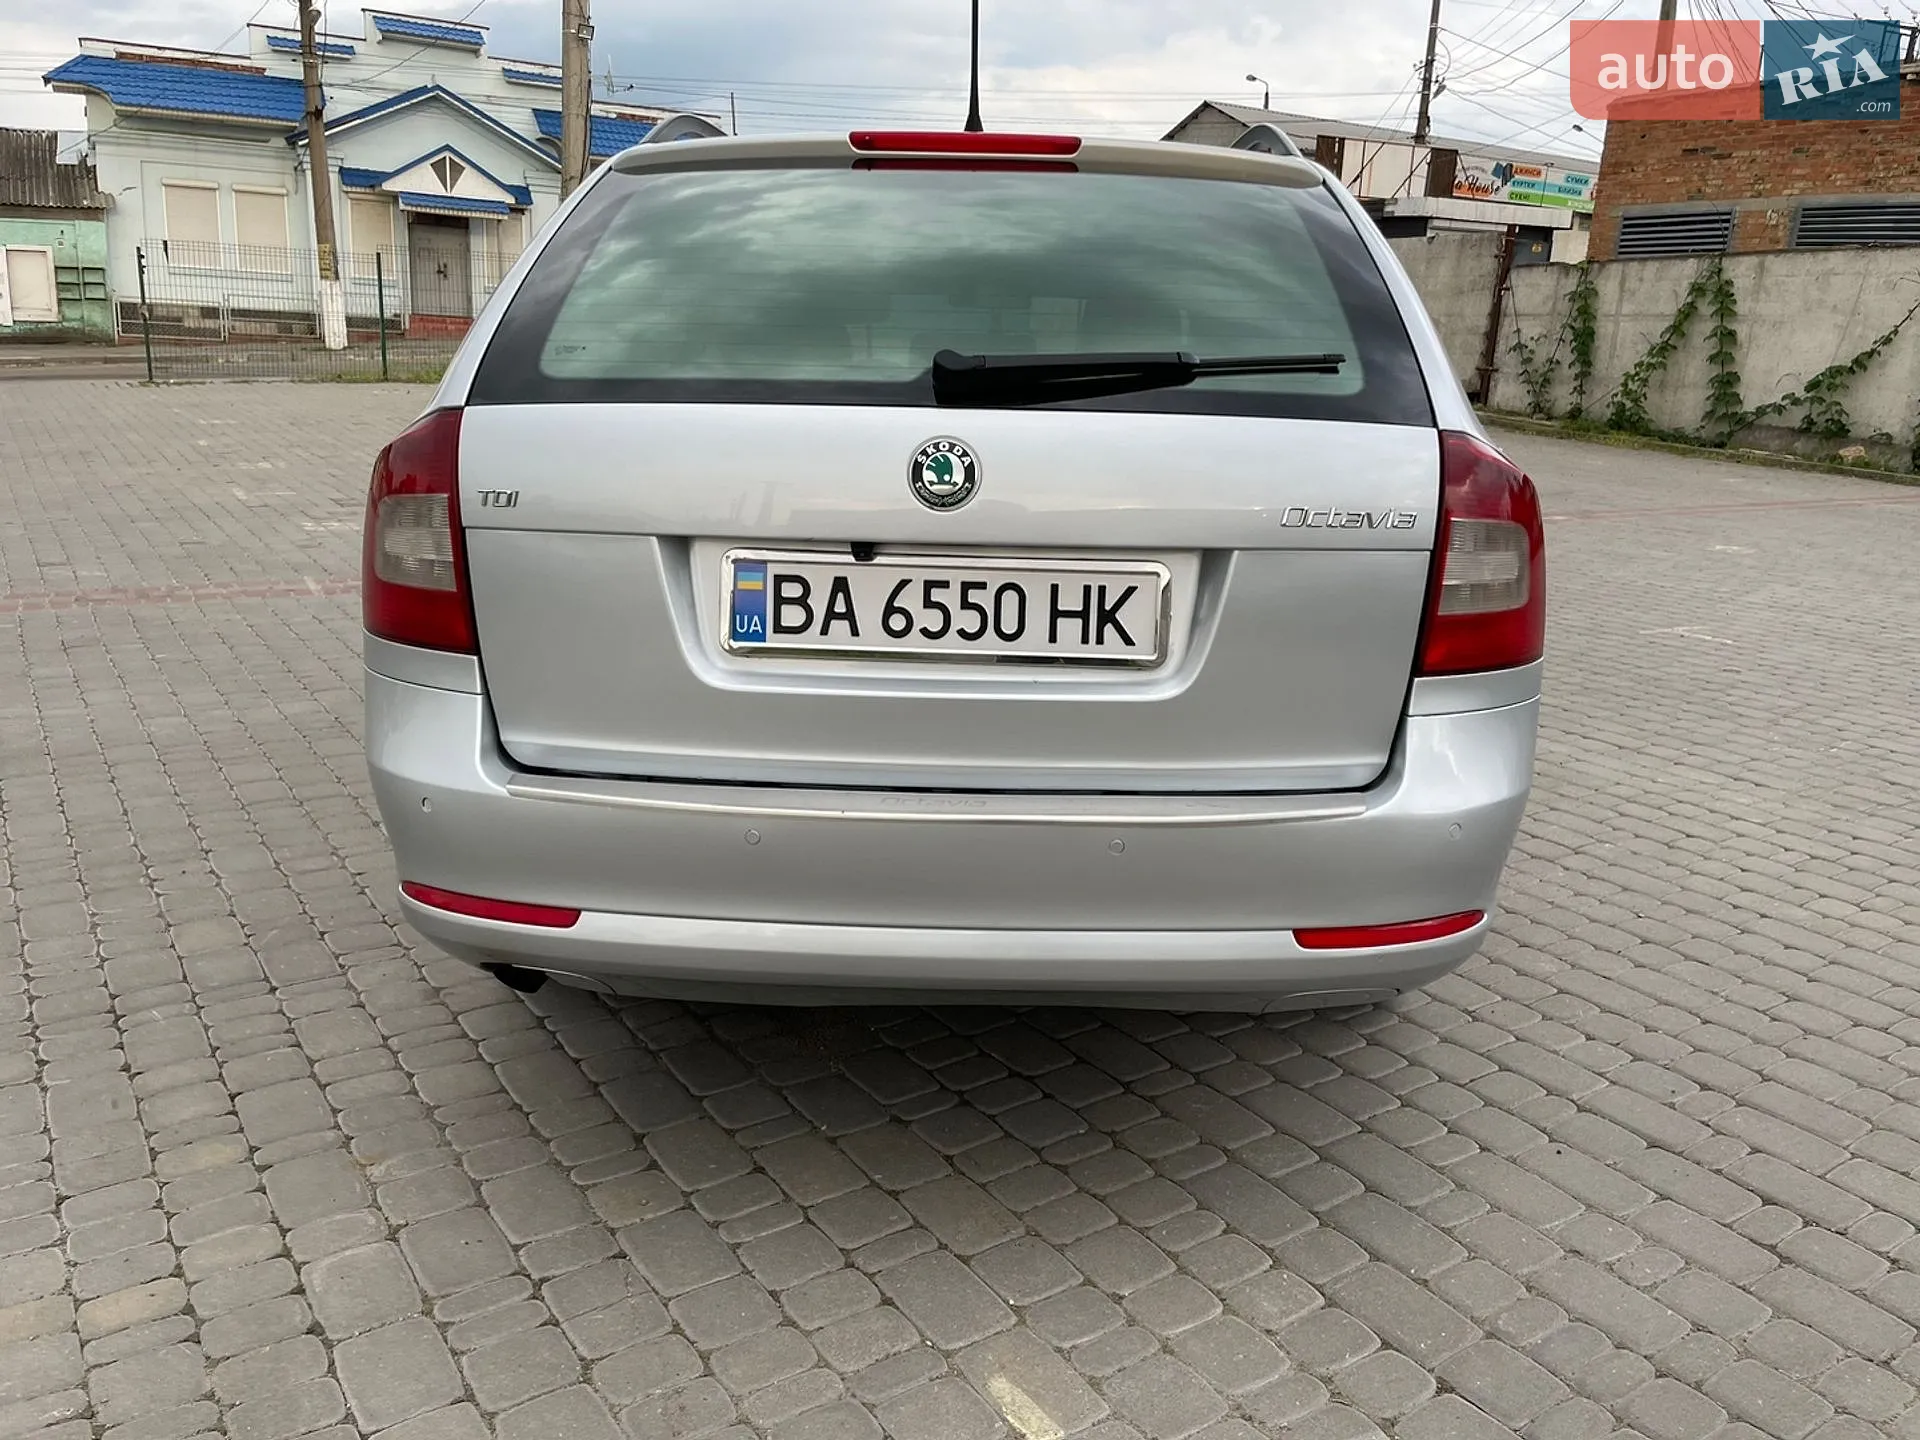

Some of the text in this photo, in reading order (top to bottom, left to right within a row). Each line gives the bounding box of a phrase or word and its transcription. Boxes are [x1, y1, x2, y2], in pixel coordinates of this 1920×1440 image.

[477, 489, 520, 508] TDI
[1280, 506, 1417, 529] Octavia
[772, 574, 1139, 647] BA 6550 HK
[735, 615, 763, 634] UA
